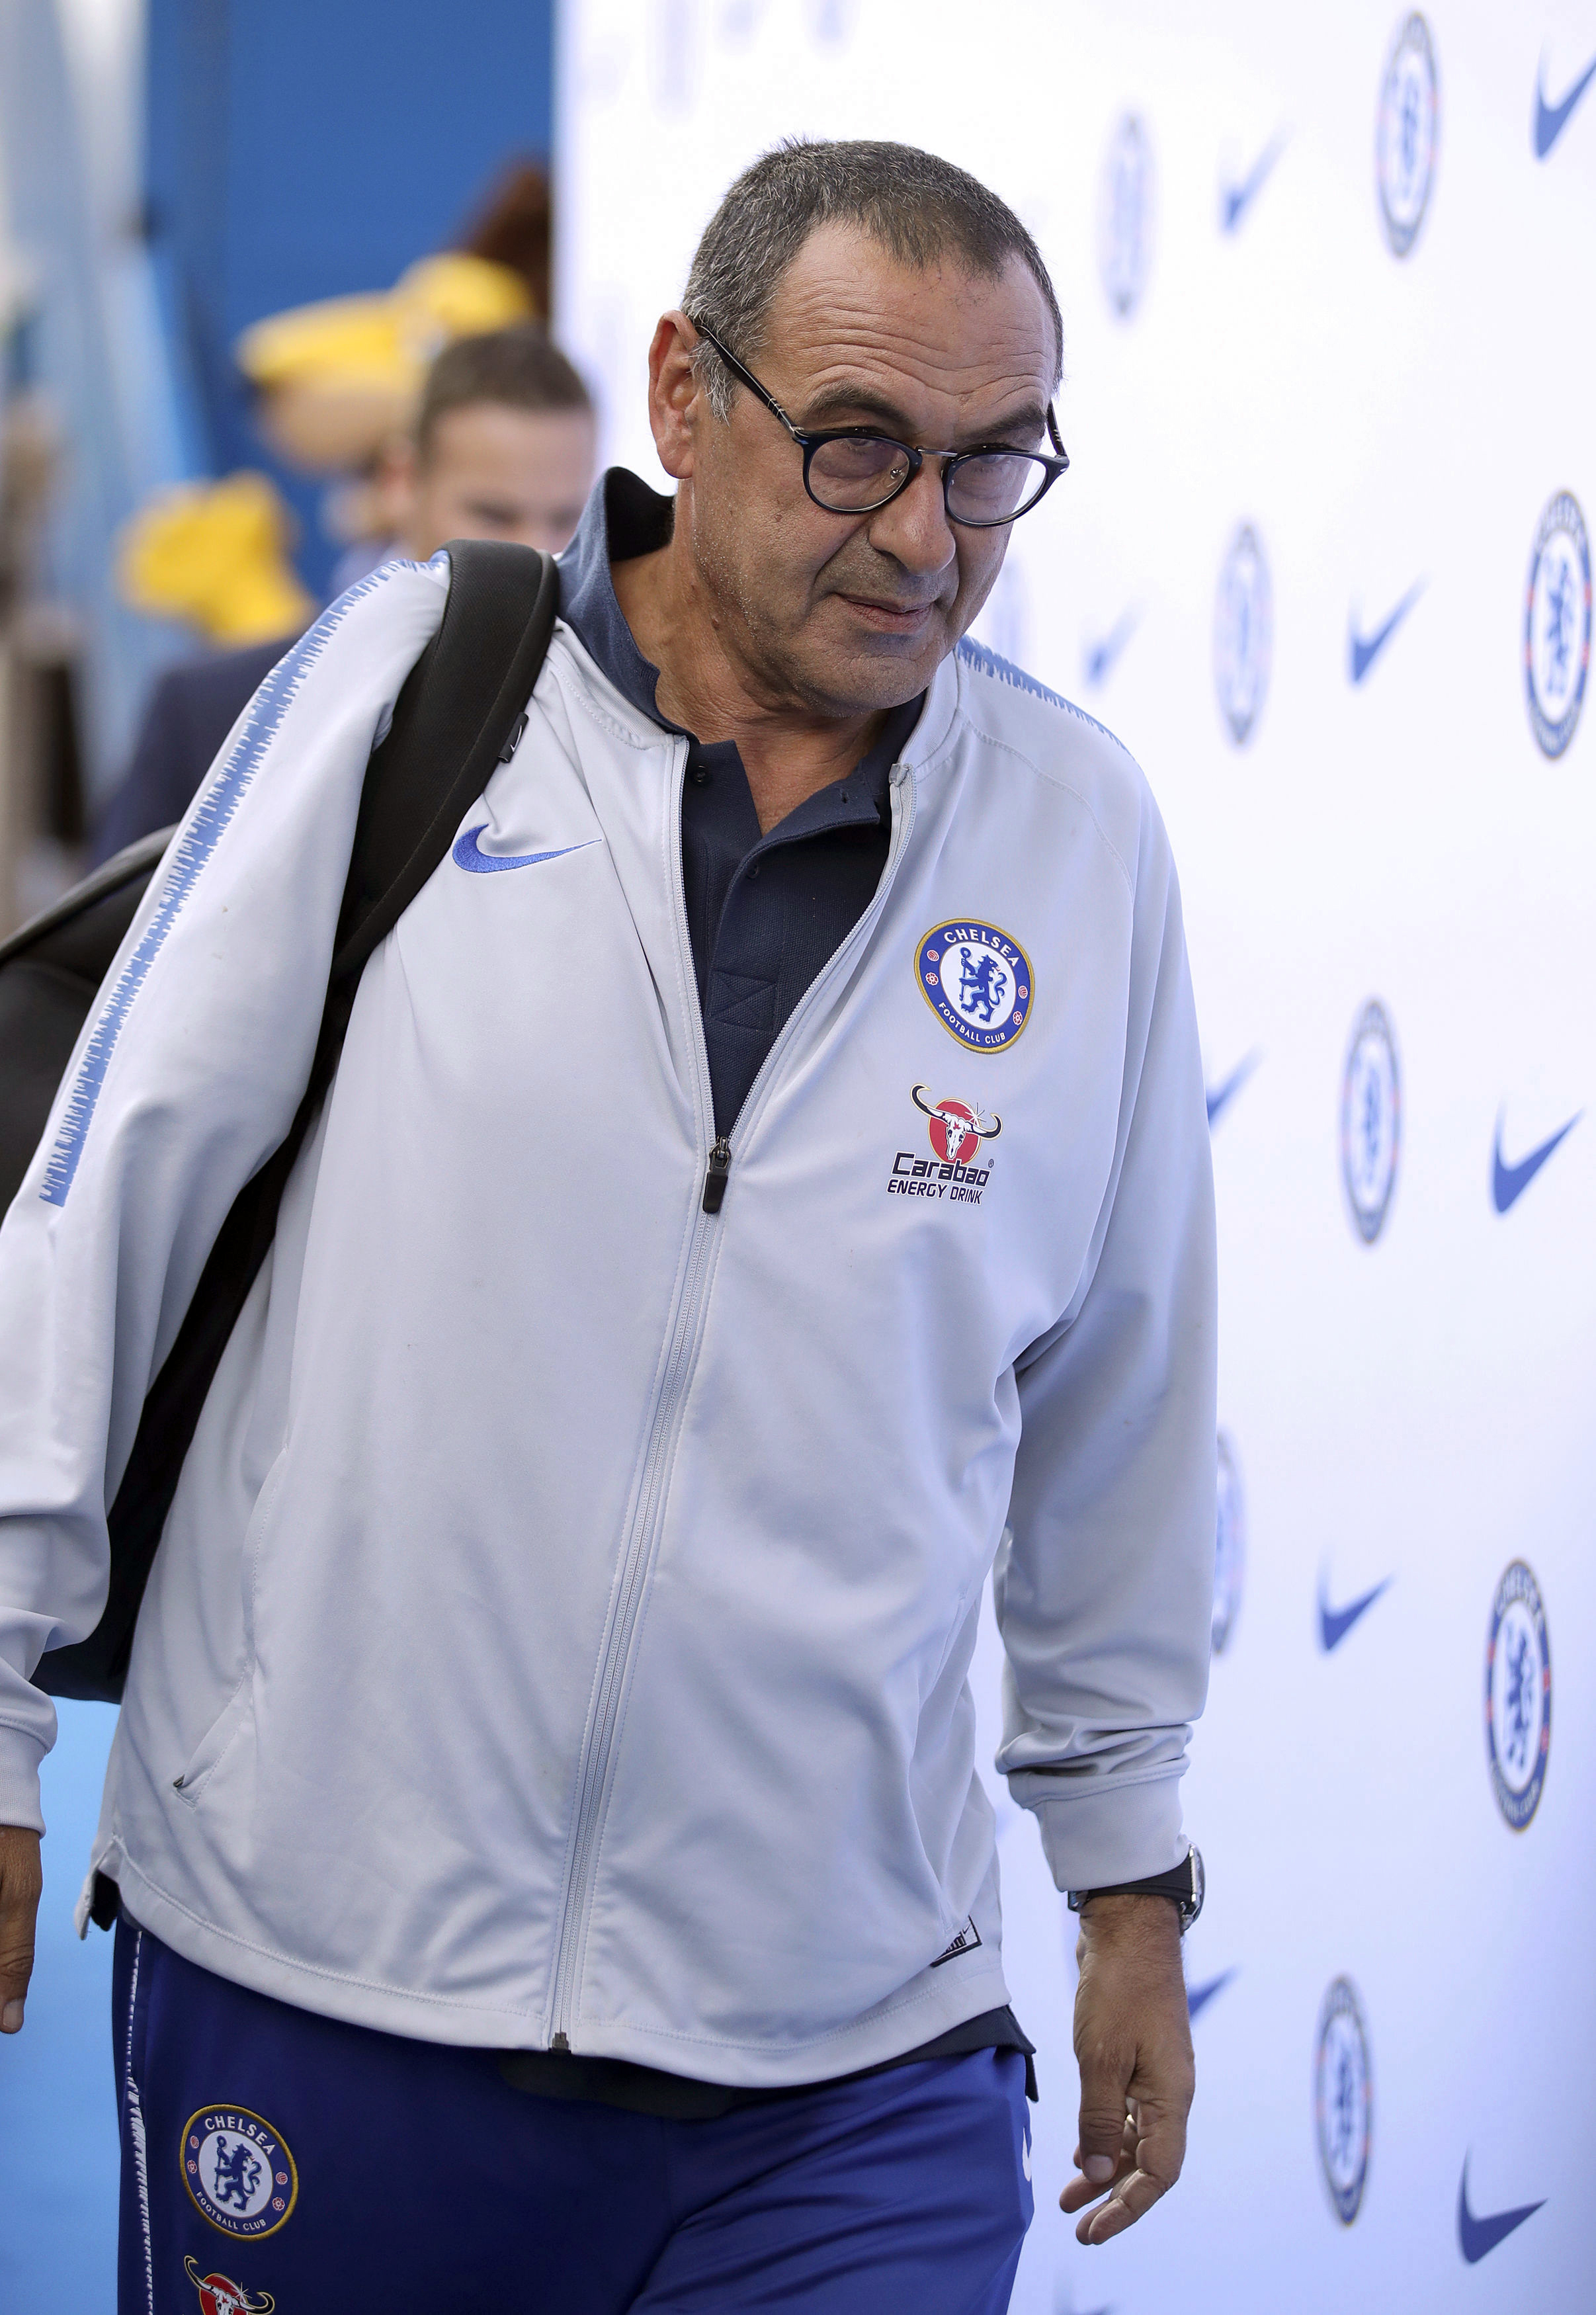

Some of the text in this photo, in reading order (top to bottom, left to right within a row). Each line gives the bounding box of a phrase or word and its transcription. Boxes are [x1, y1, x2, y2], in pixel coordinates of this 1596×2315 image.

[944, 928, 1020, 967] CHELSEA
[938, 1002, 1005, 1044] FOOTBALL CLUB
[891, 1152, 991, 1187] Carabao
[887, 1178, 983, 1204] ENERGY DRINK
[204, 2115, 276, 2155] CHELSEA
[196, 2191, 267, 2231] FOOTBALL CLUB
